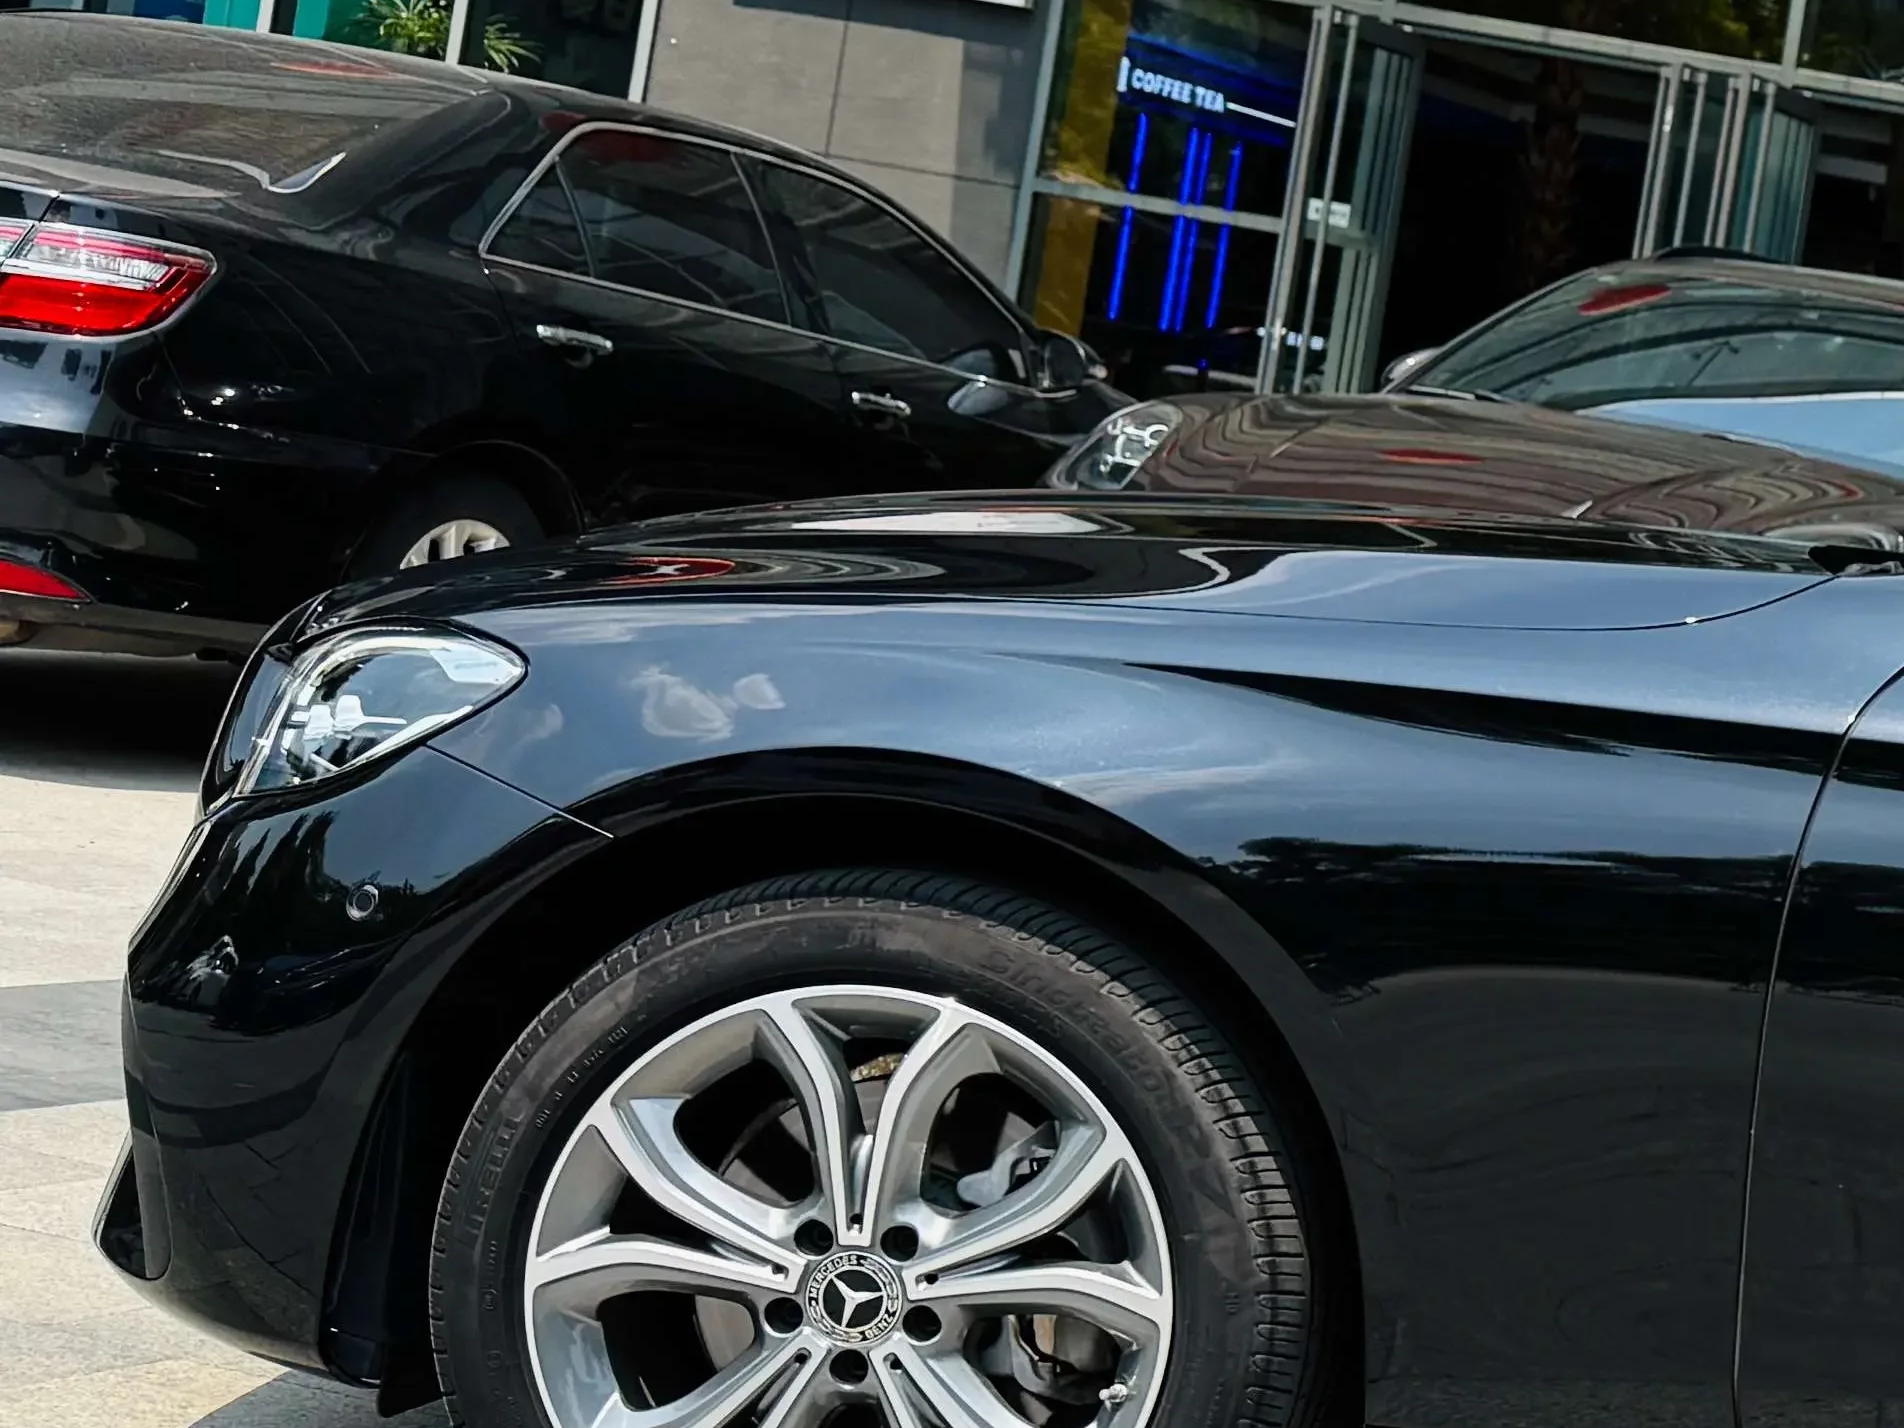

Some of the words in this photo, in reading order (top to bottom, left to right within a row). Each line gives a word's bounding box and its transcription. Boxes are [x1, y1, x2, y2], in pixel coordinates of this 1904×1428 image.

[1131, 68, 1193, 104] COFFEE
[1193, 85, 1225, 113] TEA
[808, 1254, 858, 1298] MERCEDES
[864, 1313, 893, 1339] BENZ
